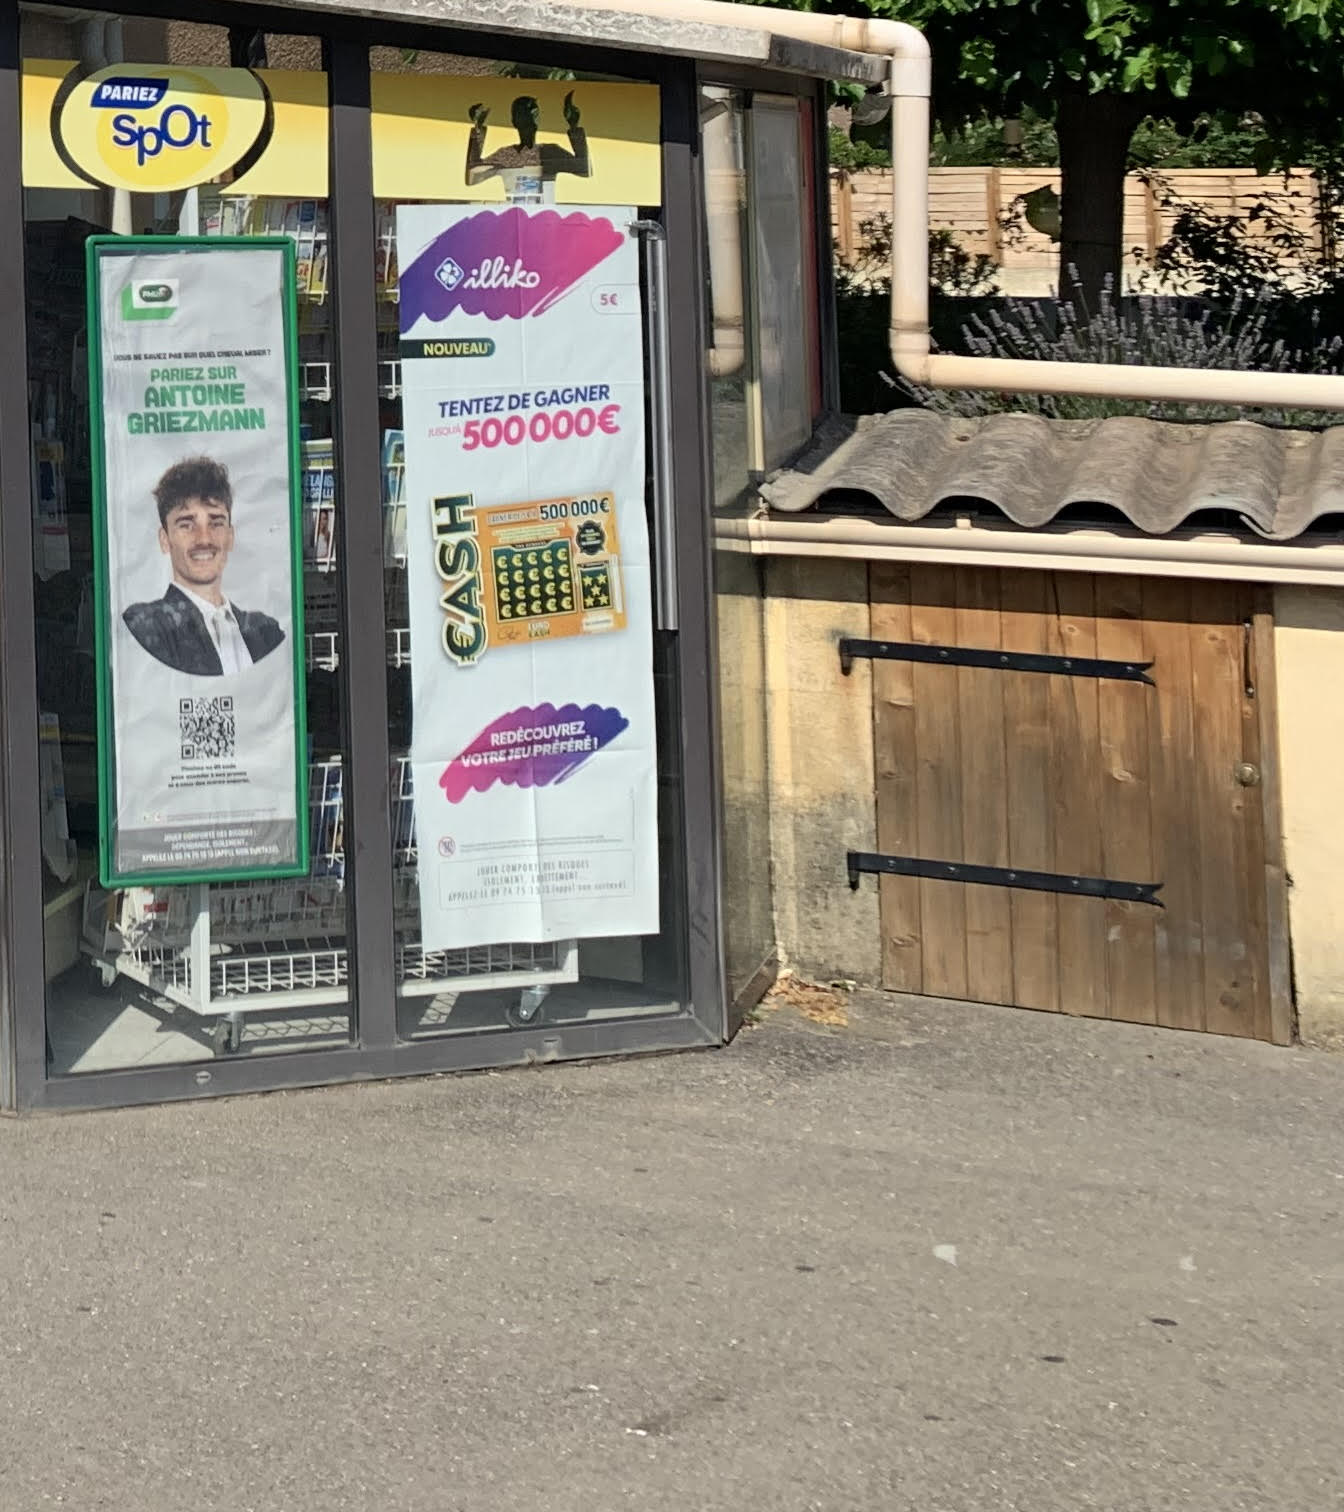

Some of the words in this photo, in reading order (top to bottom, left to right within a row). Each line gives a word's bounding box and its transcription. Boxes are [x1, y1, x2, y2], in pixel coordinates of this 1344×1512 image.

[100, 85, 159, 102] PARIEZ
[463, 256, 540, 289] illiko
[150, 367, 204, 382] PARIEZ
[207, 366, 237, 380] SUR
[145, 383, 246, 409] ANTOINE
[438, 395, 506, 418] TENTEZ
[508, 392, 531, 411] DE
[534, 384, 611, 407] GAGNER
[127, 407, 267, 435] GRIEZMANN
[462, 415, 526, 451] 500
[529, 403, 622, 442] 000€
[539, 503, 568, 521] 500
[571, 498, 598, 517] 000
[599, 497, 610, 513] €
[491, 721, 586, 747] REDÉCOUVREZ
[461, 750, 507, 768] VOTRE
[507, 745, 532, 762] JEU
[533, 735, 592, 757] PRÉFÉRÉ
